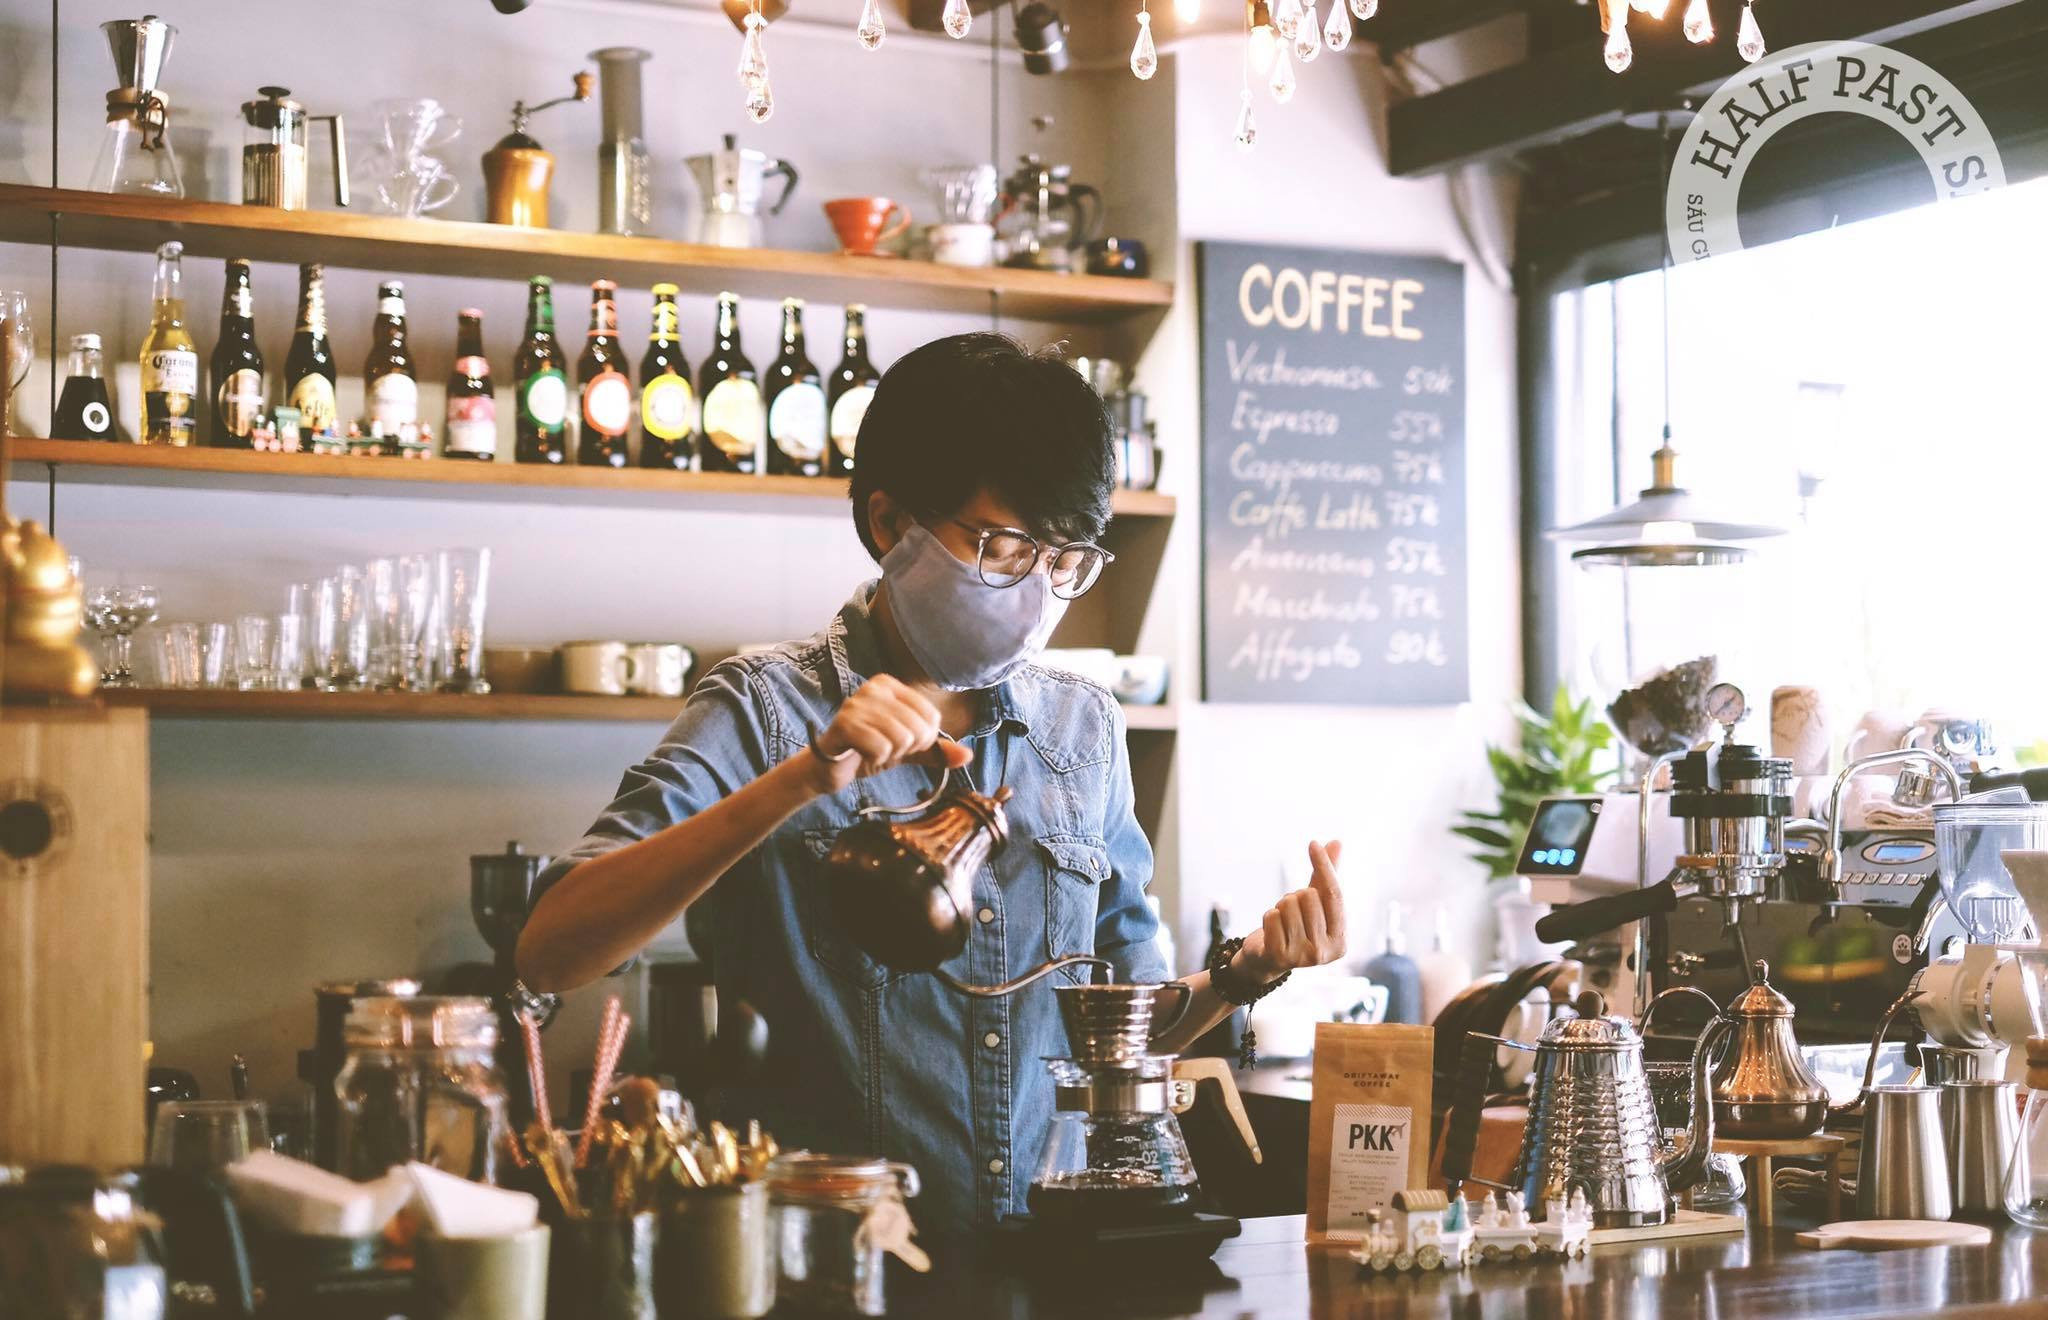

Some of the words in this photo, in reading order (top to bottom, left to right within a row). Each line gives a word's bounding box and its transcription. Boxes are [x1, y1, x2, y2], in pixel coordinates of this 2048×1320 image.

[1239, 263, 1424, 341] COFFEE
[1344, 1072, 1400, 1080] DRIFTAWAY
[1353, 1080, 1391, 1088] COFFEE
[1348, 1123, 1394, 1152] PKK
